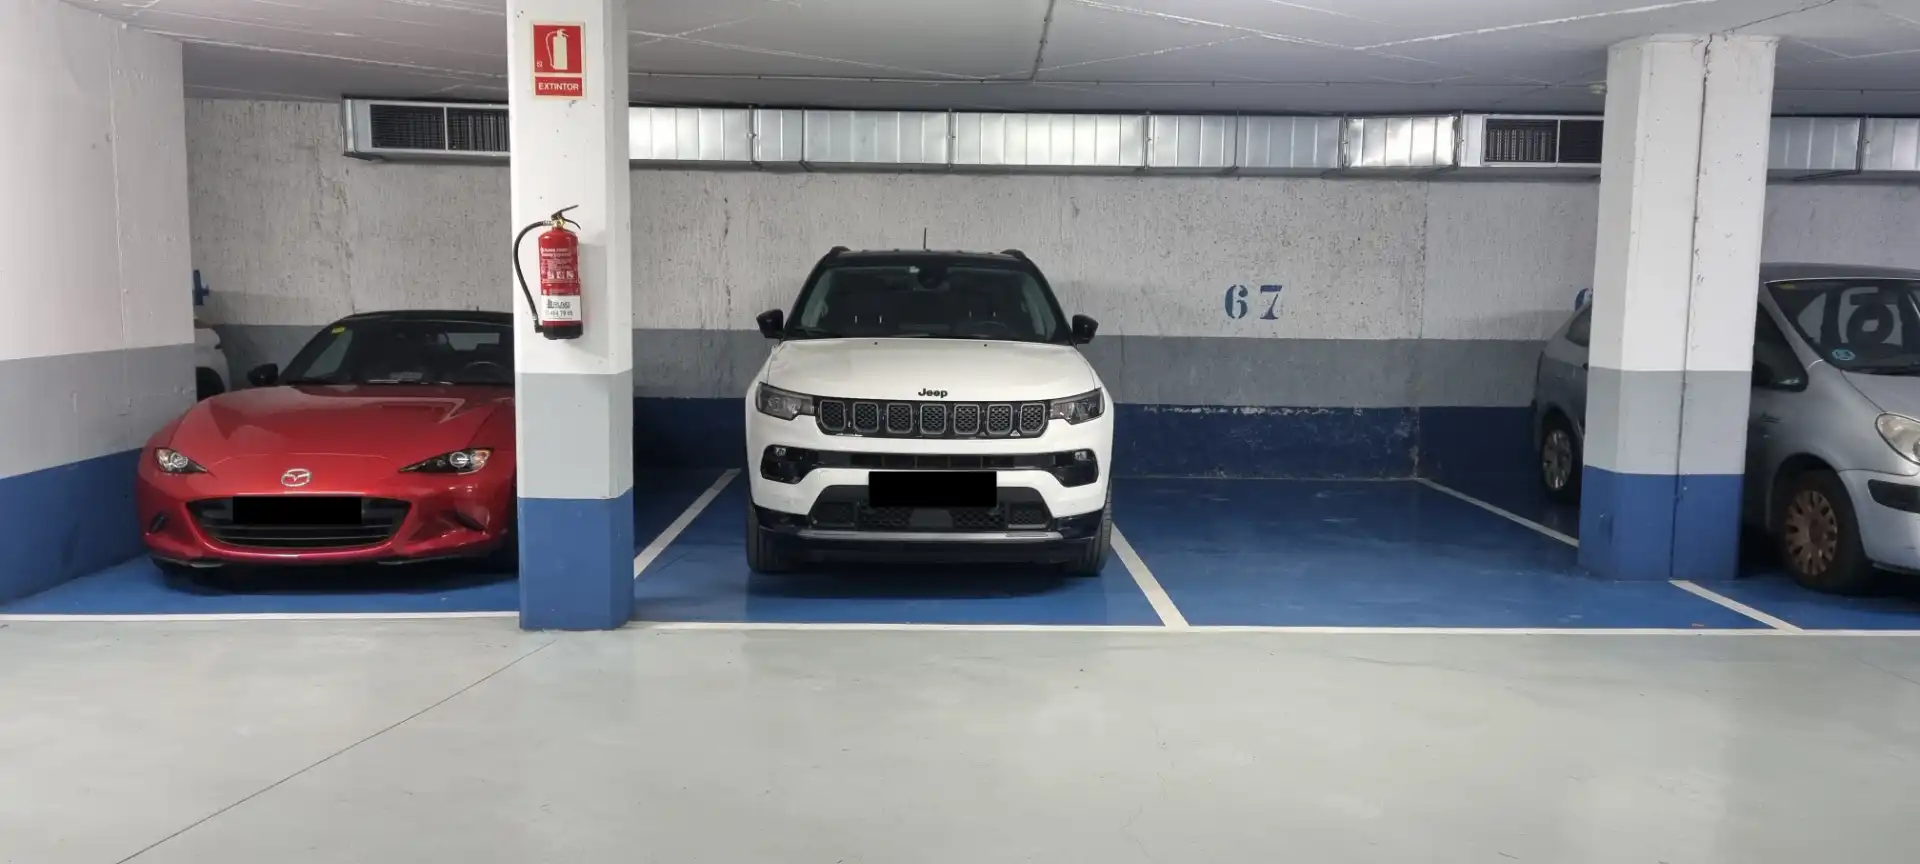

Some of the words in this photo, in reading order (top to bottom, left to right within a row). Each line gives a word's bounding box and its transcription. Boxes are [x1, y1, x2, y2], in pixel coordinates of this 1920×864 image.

[538, 82, 579, 91] EXTINTOR
[1224, 284, 1283, 320] 67
[918, 387, 949, 399] Jeep
